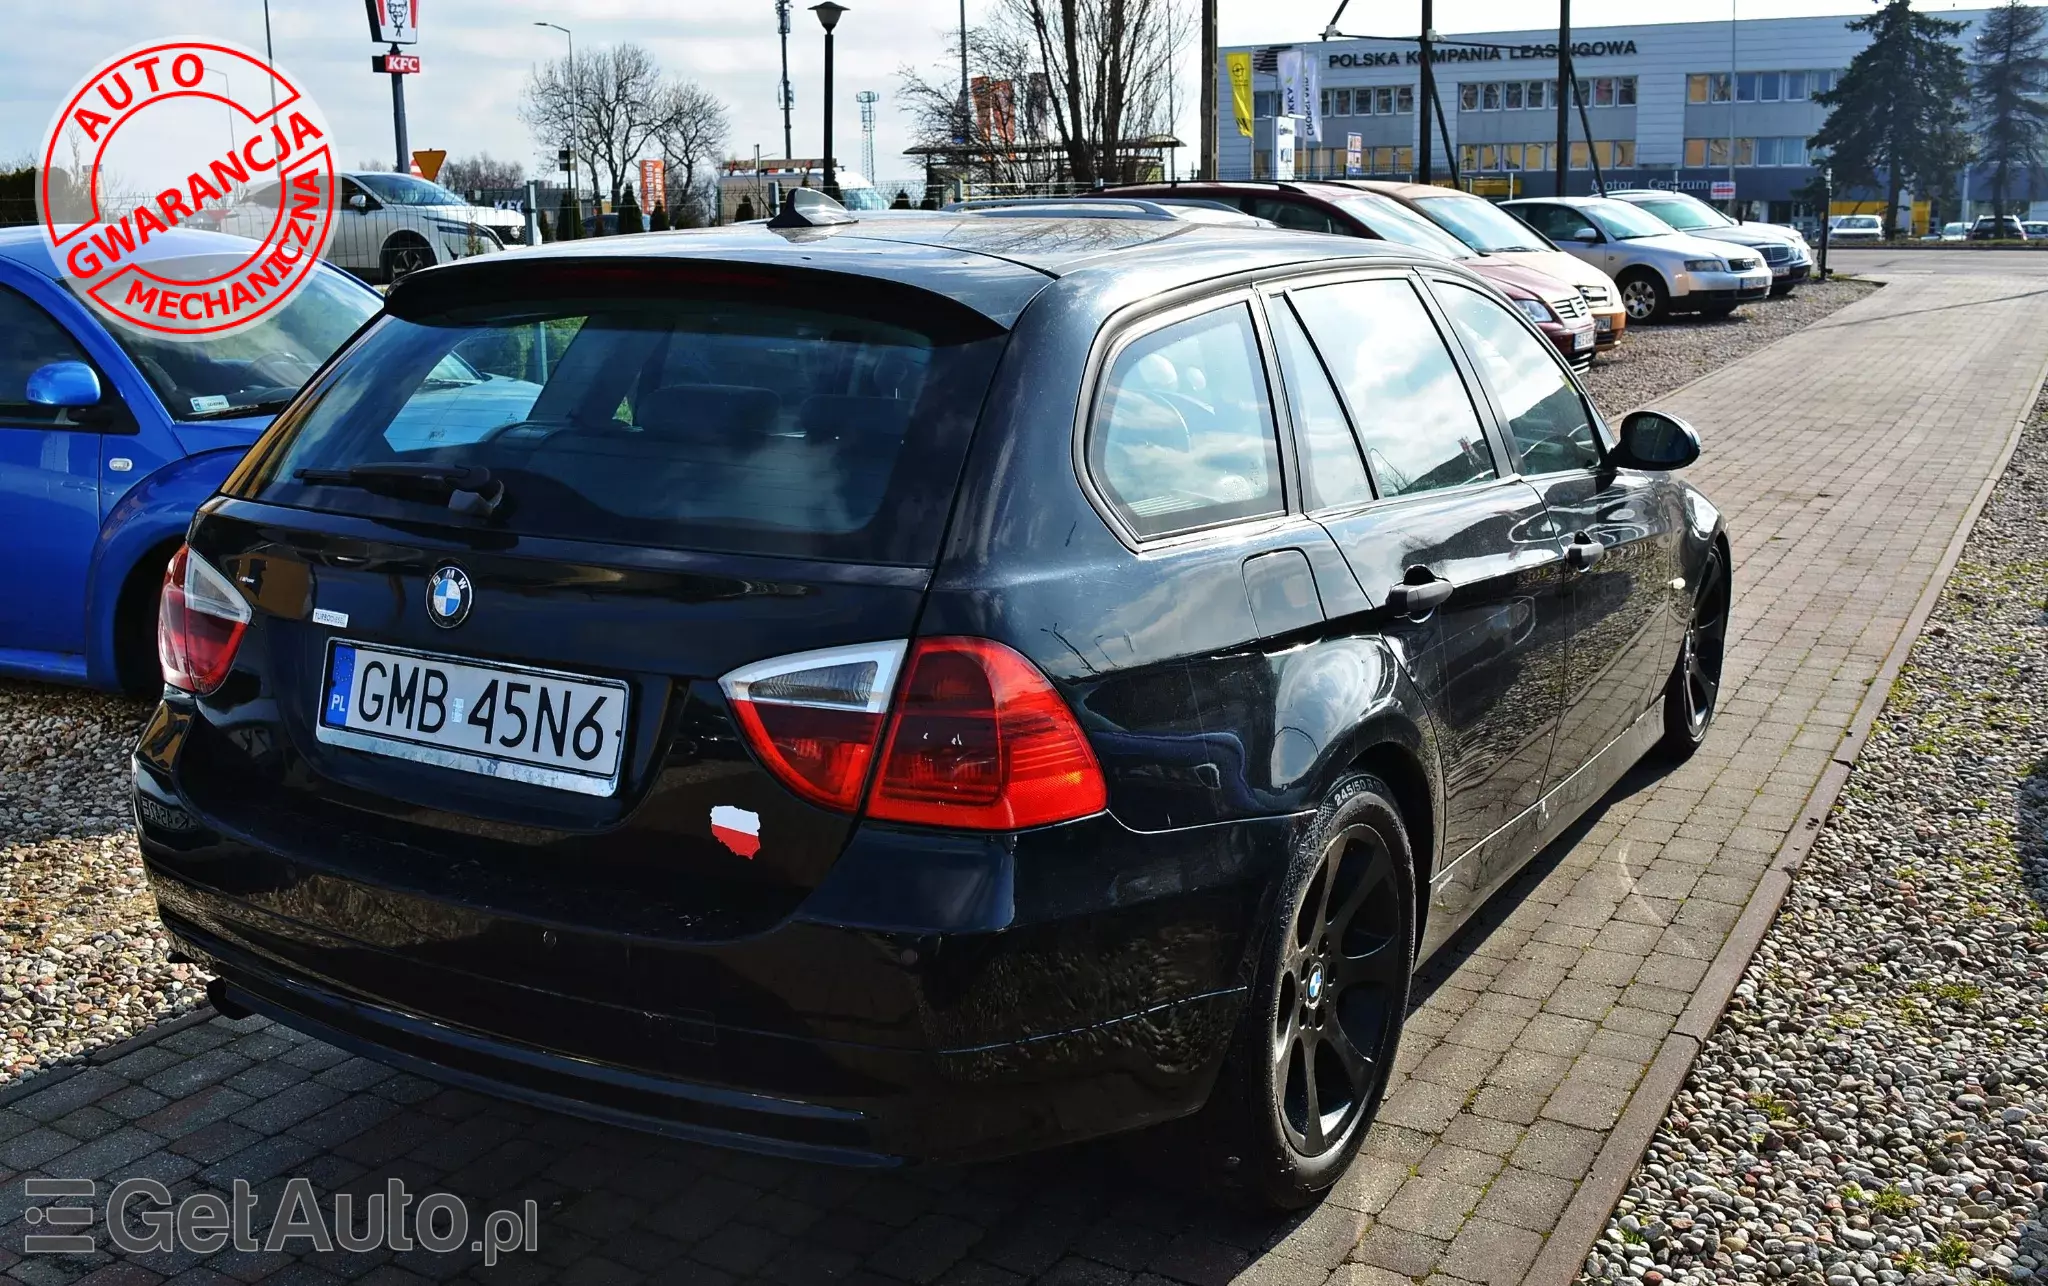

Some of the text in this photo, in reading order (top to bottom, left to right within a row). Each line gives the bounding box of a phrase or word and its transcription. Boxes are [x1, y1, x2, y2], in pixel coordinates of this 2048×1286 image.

[388, 56, 418, 71] KFC
[1329, 40, 1638, 68] POLSKA KMPANIA LEASNGOWA
[433, 569, 468, 590] BMW
[331, 660, 608, 762] PL GMB 45N6
[1334, 779, 1366, 807] 245/50
